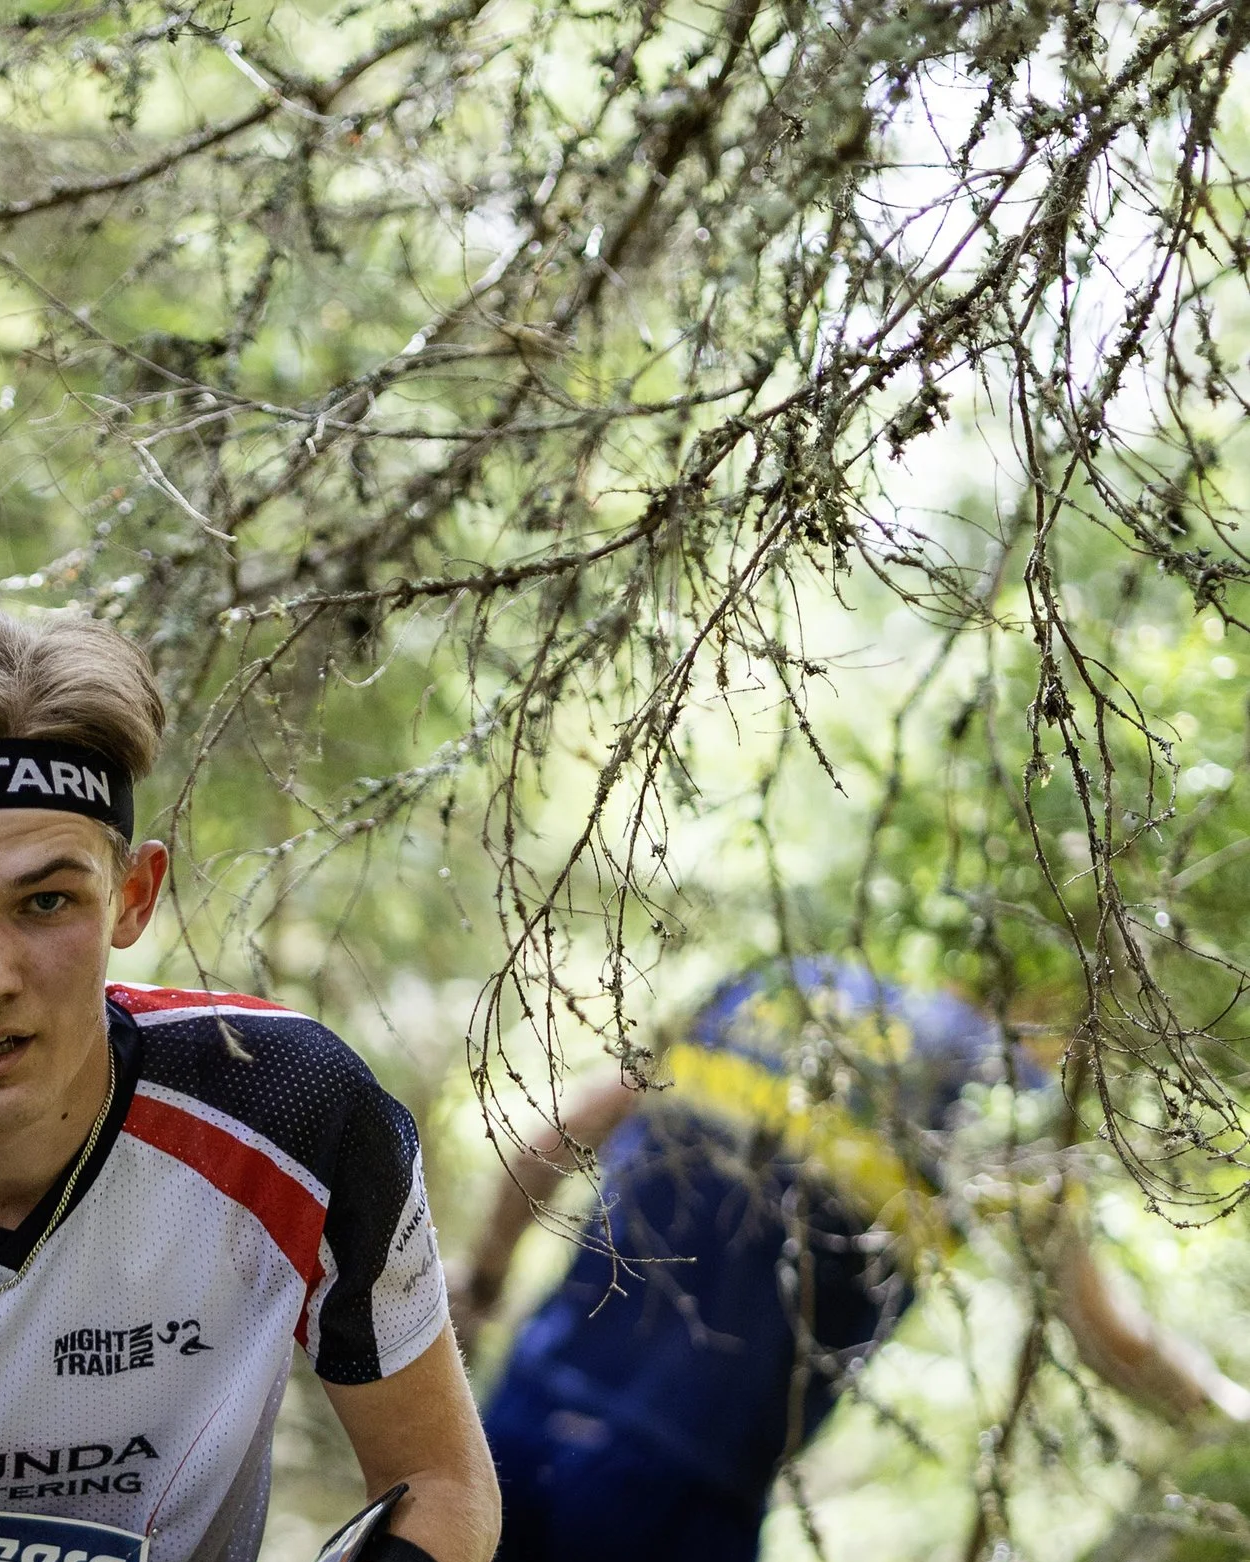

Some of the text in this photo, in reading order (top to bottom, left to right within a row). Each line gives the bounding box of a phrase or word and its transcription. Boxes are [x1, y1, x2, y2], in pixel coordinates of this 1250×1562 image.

[53, 1328, 128, 1358] NIGHT
[129, 1322, 154, 1370] RUN
[53, 1352, 129, 1376] TRAIL
